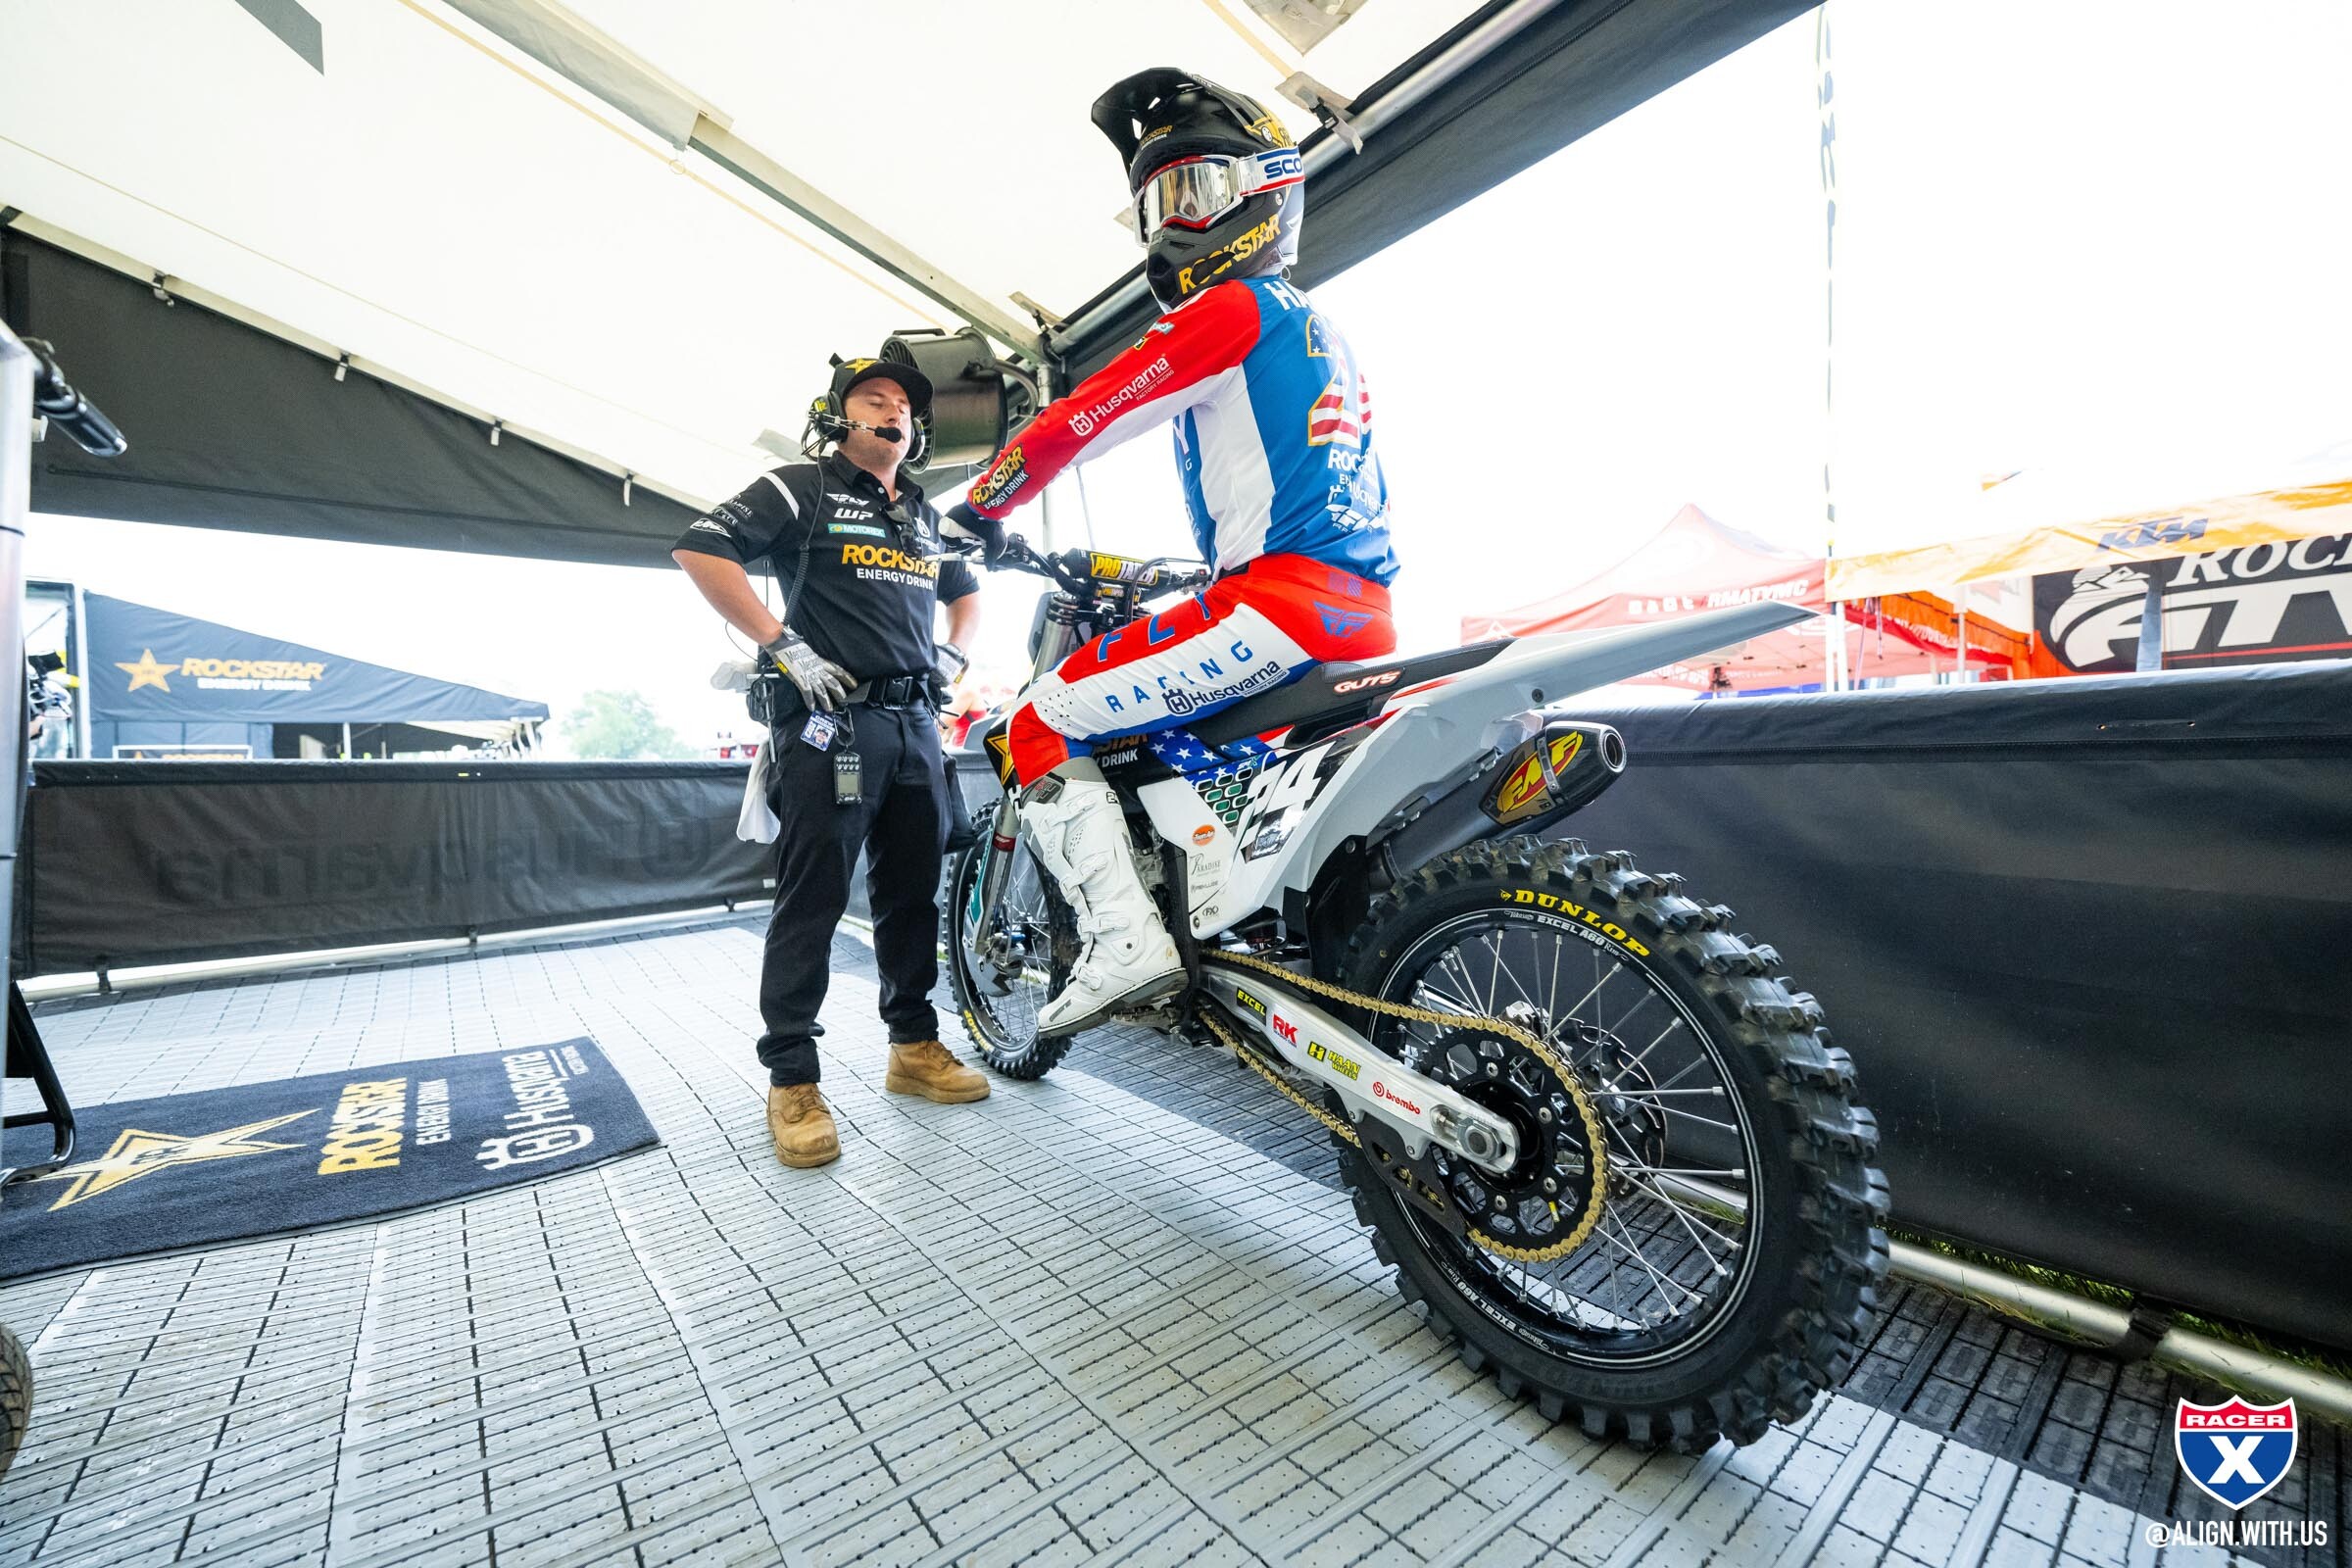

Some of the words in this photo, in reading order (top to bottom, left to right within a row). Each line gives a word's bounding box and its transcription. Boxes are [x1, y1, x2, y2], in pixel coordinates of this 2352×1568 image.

[1089, 357, 1169, 422] Husqvarna
[1137, 383, 1157, 401] FACTORY
[1157, 369, 1174, 386] RACING
[1004, 469, 1029, 496] DRINK
[834, 508, 874, 520] WP
[2096, 517, 2209, 552] KTM
[2166, 534, 2352, 588] ROC
[857, 568, 906, 584] ENERGY
[906, 574, 934, 592] DRINK
[180, 658, 326, 680] ROCKSTAR
[1189, 661, 1281, 707] Husqvarna
[1334, 670, 1401, 693] GUTS
[1102, 749, 1138, 768] DRINK
[1501, 731, 1579, 813] FMF
[1514, 889, 1650, 957] DUNLOP
[1537, 914, 1578, 934] EXCEL
[1579, 928, 1605, 947] A60
[1237, 989, 1266, 1016] EXCEL
[1273, 1013, 1298, 1044] RK
[1328, 1051, 1361, 1074] HAAN
[1332, 1063, 1358, 1081] WHEELS
[416, 1079, 450, 1103] DRINK
[502, 1051, 574, 1131] Husqvarna
[1385, 1089, 1421, 1115] brembo
[318, 1078, 408, 1175] ROCKSTAR
[416, 1102, 451, 1146] ENERGY
[1457, 1281, 1480, 1302] A60
[1480, 1298, 1516, 1332] EXCEL
